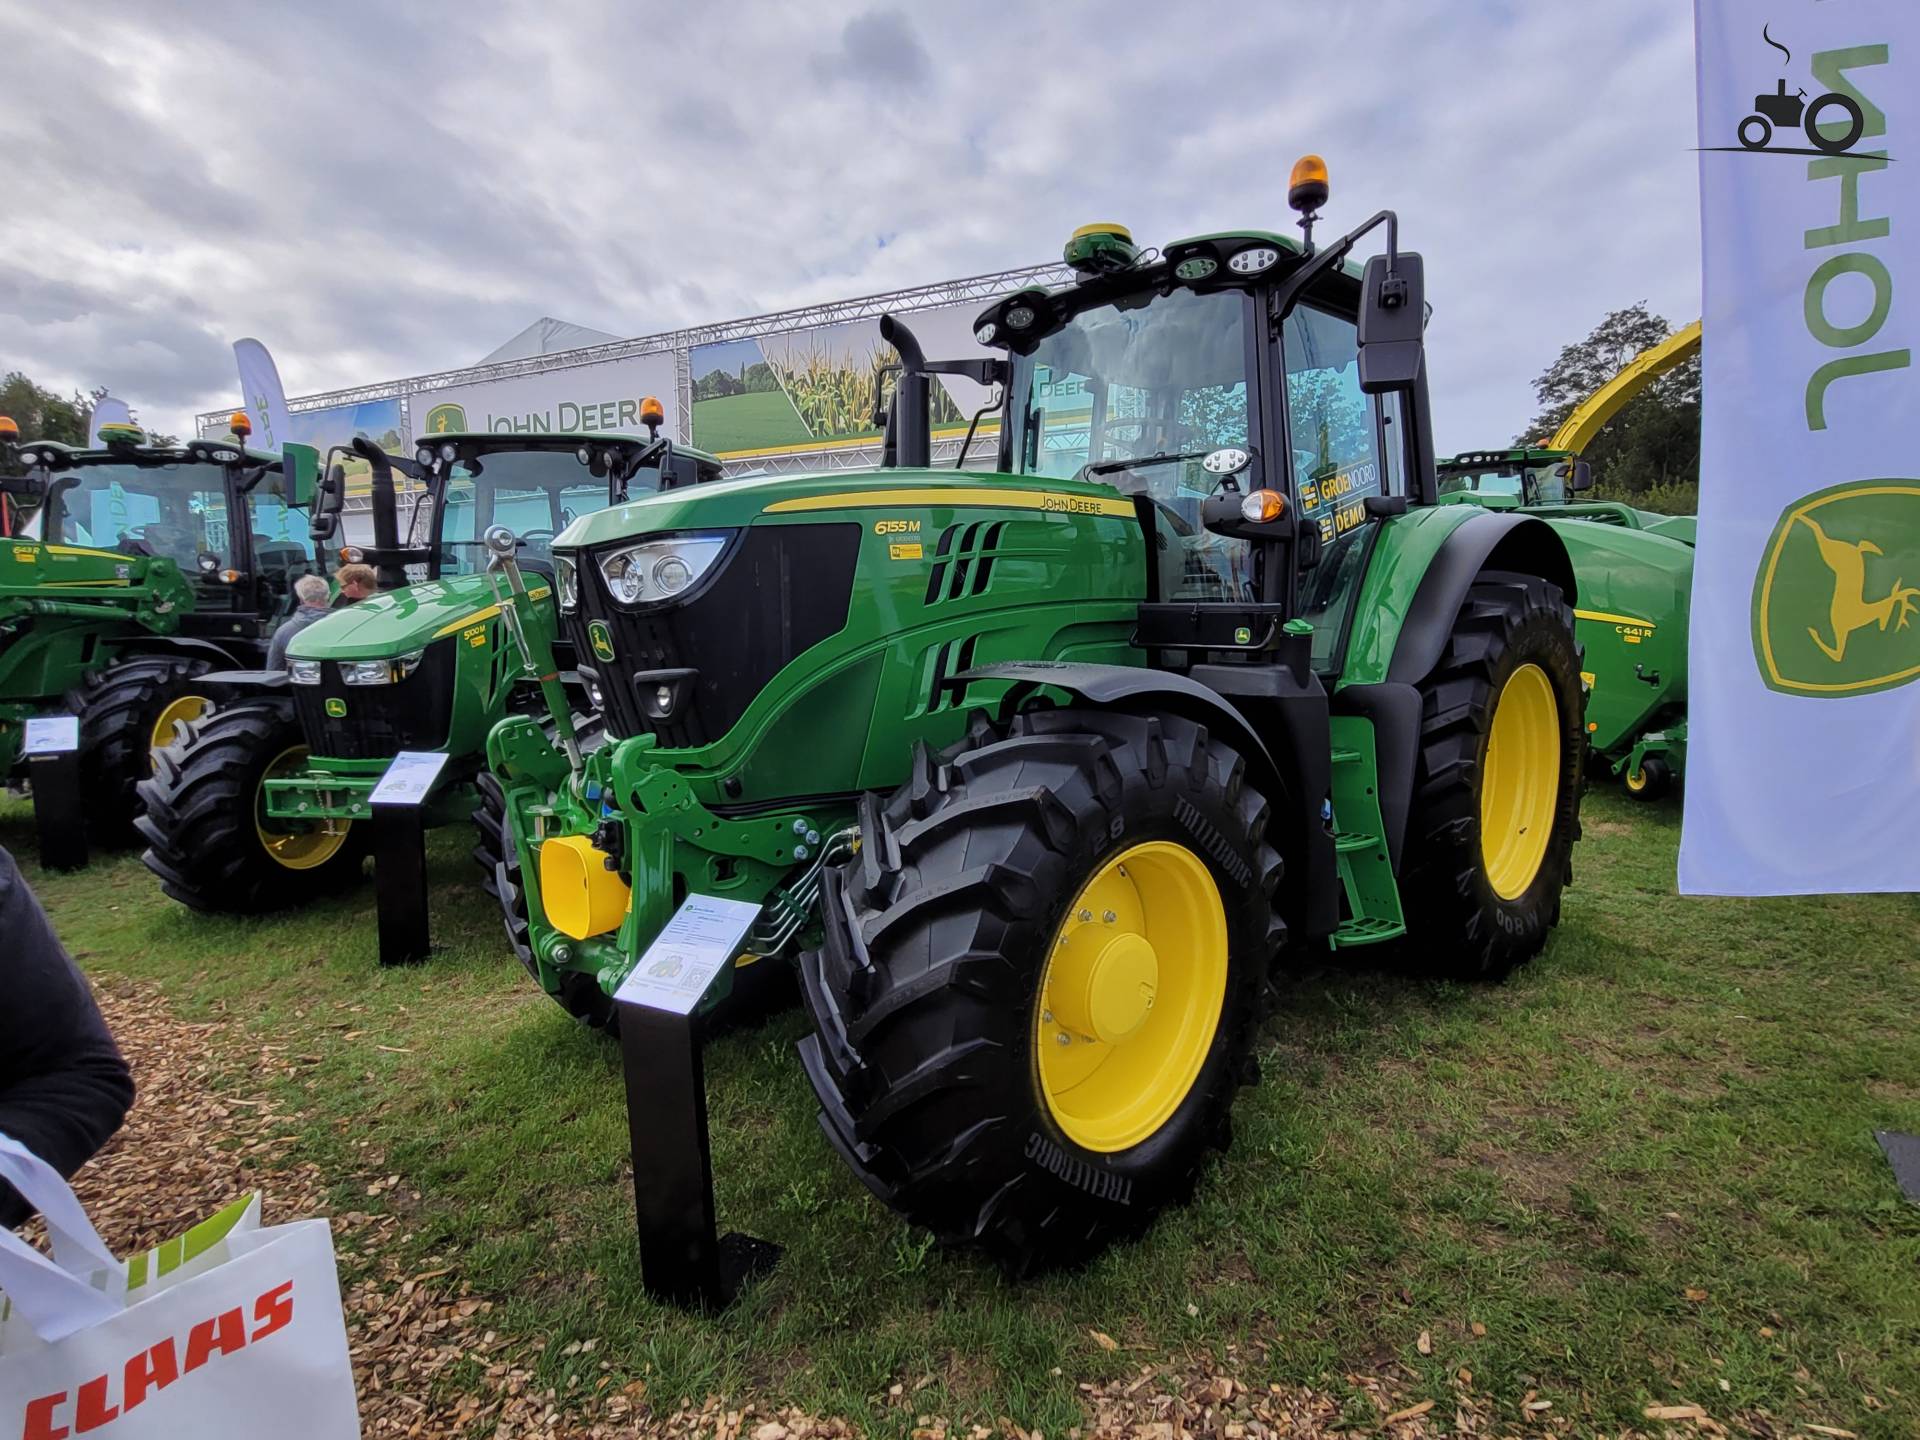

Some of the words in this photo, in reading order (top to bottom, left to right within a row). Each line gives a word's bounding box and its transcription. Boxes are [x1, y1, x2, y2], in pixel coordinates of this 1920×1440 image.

[558, 399, 645, 433] DEER
[1321, 463, 1376, 500] GROENOORD
[1335, 503, 1366, 533] DEMO
[1172, 793, 1253, 889] TRELLEBORG
[1024, 1131, 1133, 1206] TRELLEBORG
[23, 1279, 294, 1440] CLAAS
